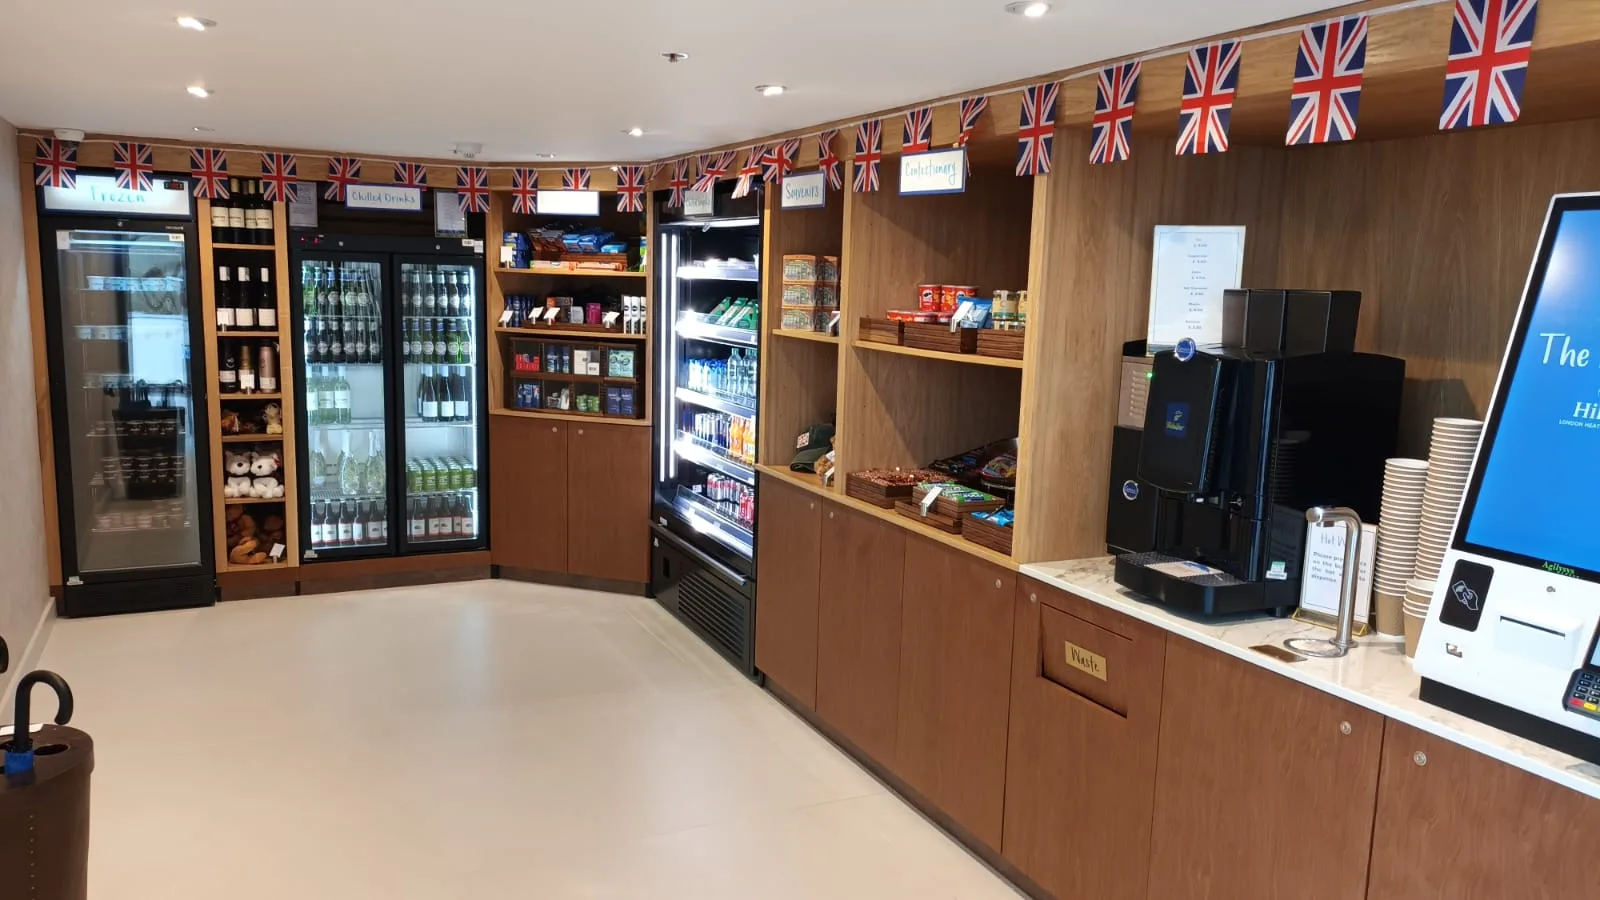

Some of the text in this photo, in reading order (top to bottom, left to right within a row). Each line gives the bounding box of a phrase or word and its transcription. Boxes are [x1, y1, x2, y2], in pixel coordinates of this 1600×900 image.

[90, 184, 145, 203] Frozen
[352, 191, 416, 203] Chilled Drinks
[785, 182, 819, 200] Souvenirs
[1539, 333, 1590, 367] The
[1559, 419, 1584, 427] LONDON
[1542, 560, 1576, 576] Agilysys
[1071, 647, 1100, 673] Waste
